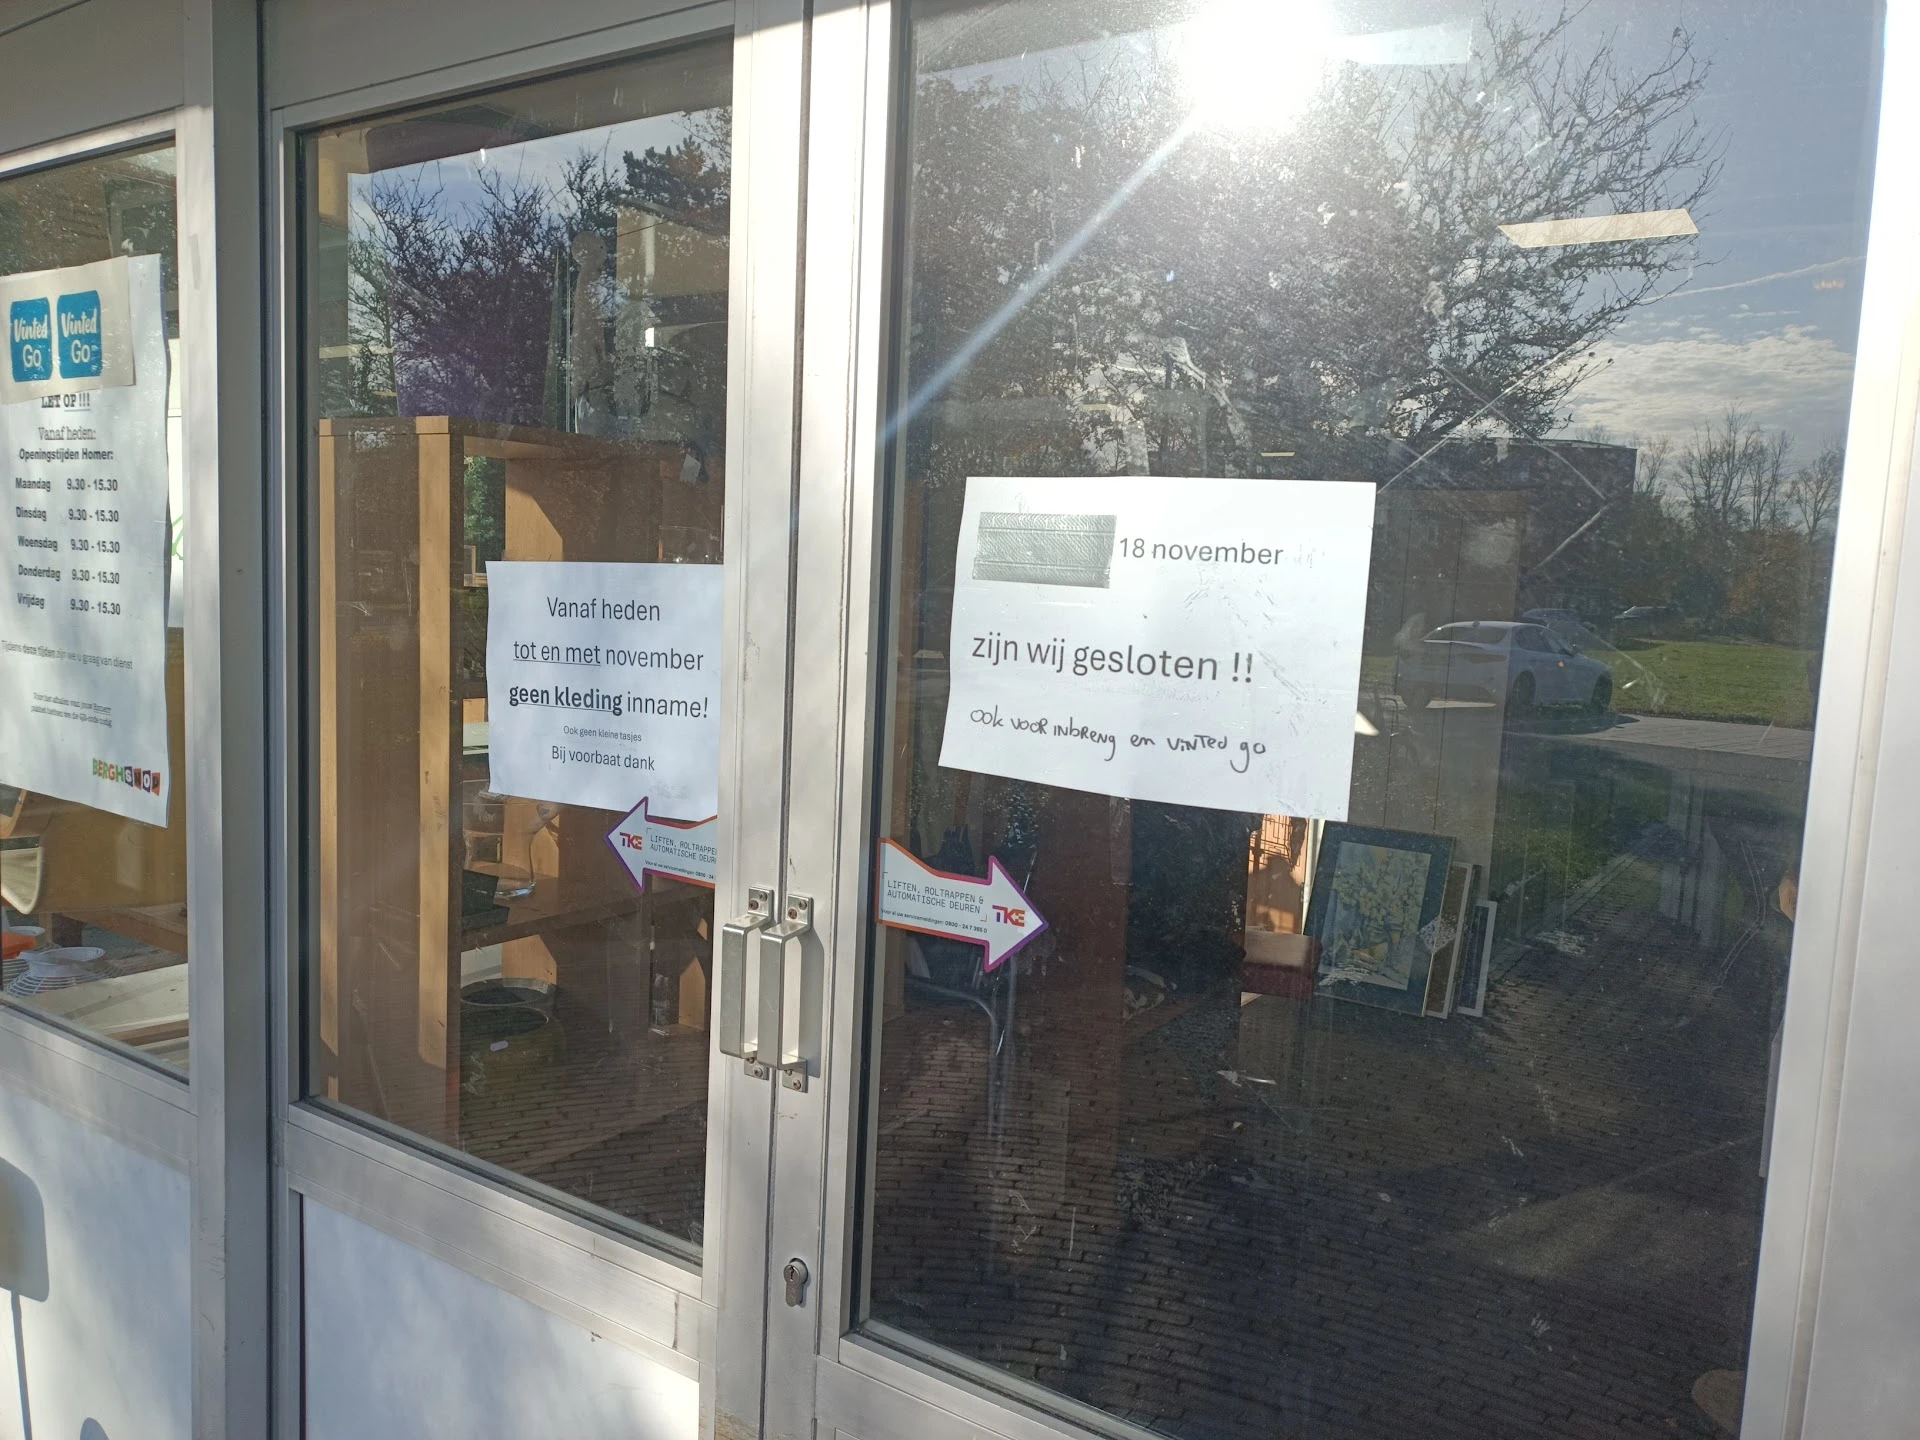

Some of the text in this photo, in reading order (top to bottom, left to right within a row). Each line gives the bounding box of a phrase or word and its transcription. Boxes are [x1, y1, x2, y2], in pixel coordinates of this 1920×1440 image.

[14, 315, 48, 342] Vinted
[61, 308, 97, 337] Vinted
[23, 344, 42, 367] Go
[71, 340, 91, 363] Go
[41, 392, 90, 408] LET OP !!!
[39, 426, 96, 440] Vanaf heden:
[19, 448, 113, 463] Openingstijden Homer:
[15, 477, 51, 492] Maandag
[67, 478, 85, 490] 9.30
[94, 479, 118, 491] 15.30
[16, 506, 47, 522] Dinsdag
[68, 508, 87, 521] 9.30
[95, 510, 119, 522] 15.30
[18, 535, 58, 552] Woensdag
[70, 538, 89, 551] 9.30
[97, 540, 120, 553] 15.30
[1120, 538, 1284, 565] 18 november
[18, 564, 61, 582] Donderdag
[71, 569, 90, 581] 9.30
[98, 571, 120, 584] 15.30
[17, 592, 45, 609] Vrijdag
[70, 599, 89, 611] 9.30
[98, 601, 121, 615] 15.30
[547, 597, 660, 621] Vanaf heden
[101, 657, 113, 666] van
[114, 657, 133, 669] dienst
[514, 641, 704, 670] tot en met november
[972, 632, 1253, 683] zijn wij gesloten !!
[509, 686, 708, 718] geen kleding inname!
[563, 725, 642, 742] Ook geen kleine tasjes
[552, 745, 655, 771] Bij voorbaat dank
[1131, 732, 1155, 747] en
[1231, 741, 1266, 773] go
[620, 832, 642, 850] TKE
[650, 835, 677, 848] LIFTEN,
[650, 844, 697, 860] AUTOMATISCHE
[887, 880, 984, 904] LIFTEN, ROLTRAPPEN &
[887, 889, 980, 914] AUTOMATISCHE DEUREN
[992, 905, 1025, 927] TKE
